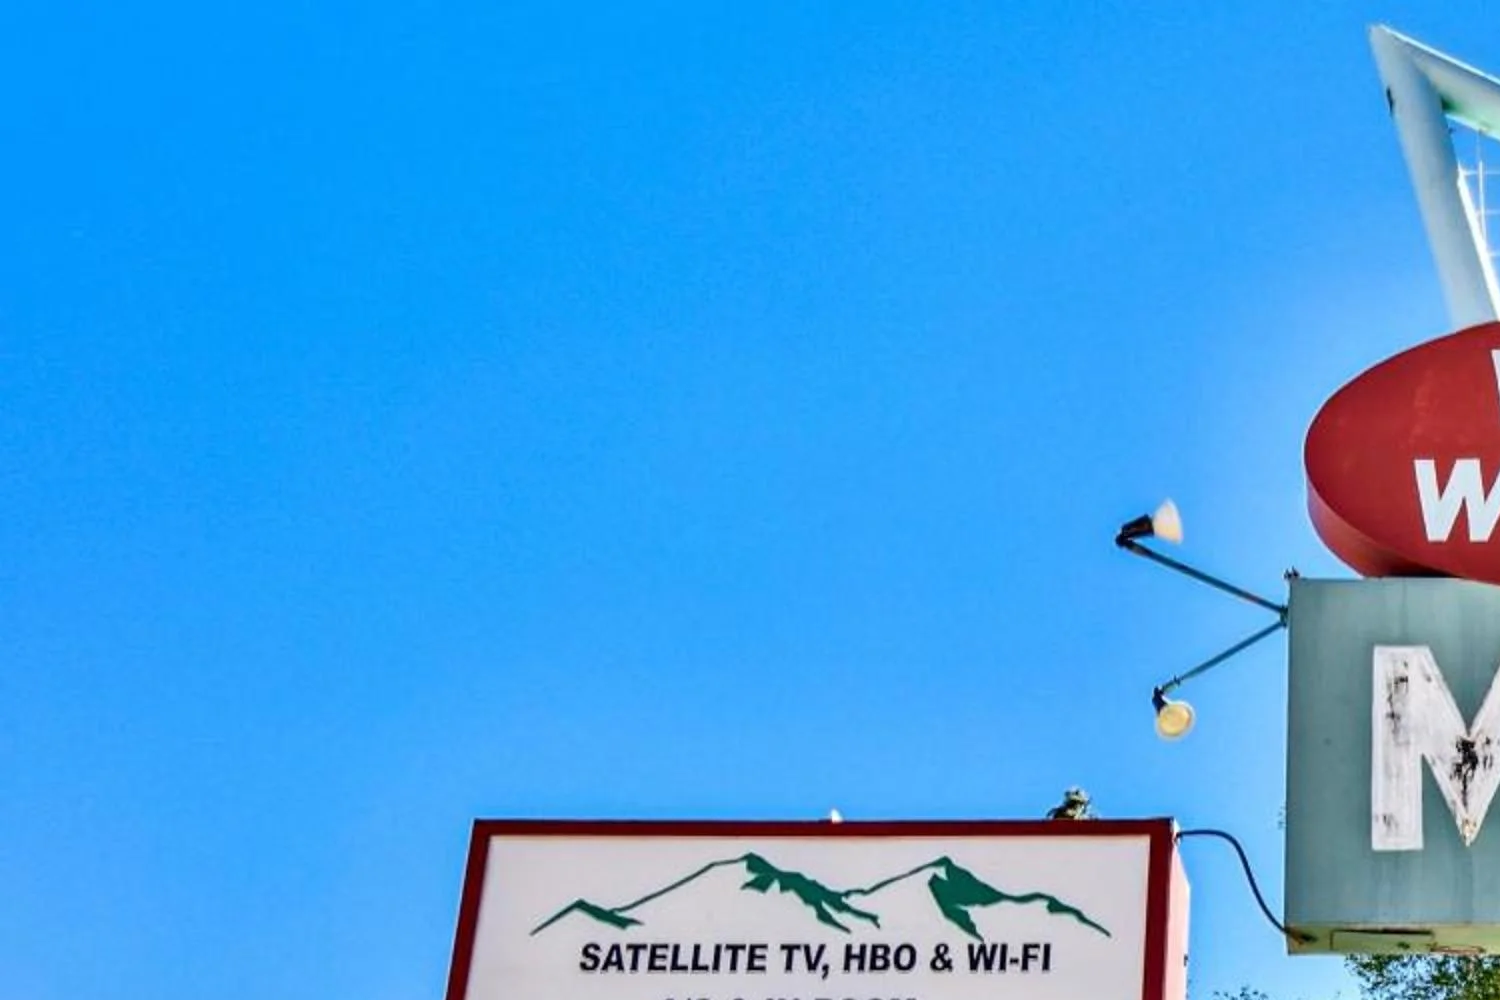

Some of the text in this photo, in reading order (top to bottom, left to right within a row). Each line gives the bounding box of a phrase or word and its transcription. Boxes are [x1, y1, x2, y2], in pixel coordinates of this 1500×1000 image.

[579, 943, 1052, 979] SATELLITE TV, HBO & WI-FI
